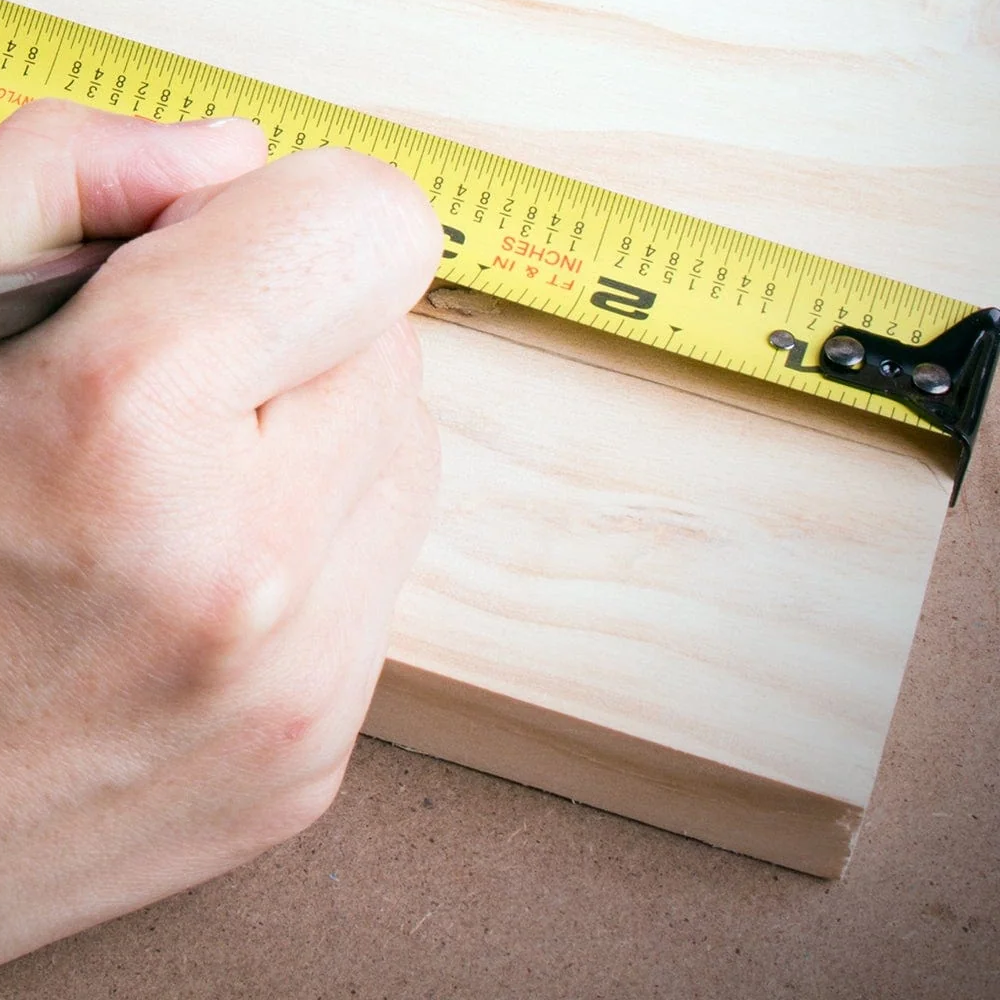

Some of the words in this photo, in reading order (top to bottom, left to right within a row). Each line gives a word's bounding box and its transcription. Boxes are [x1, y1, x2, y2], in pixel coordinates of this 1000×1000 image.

[501, 235, 583, 274] INCHES
[492, 255, 516, 272] IN
[525, 264, 539, 279] &
[546, 274, 575, 291] FT
[589, 275, 658, 321] 2
